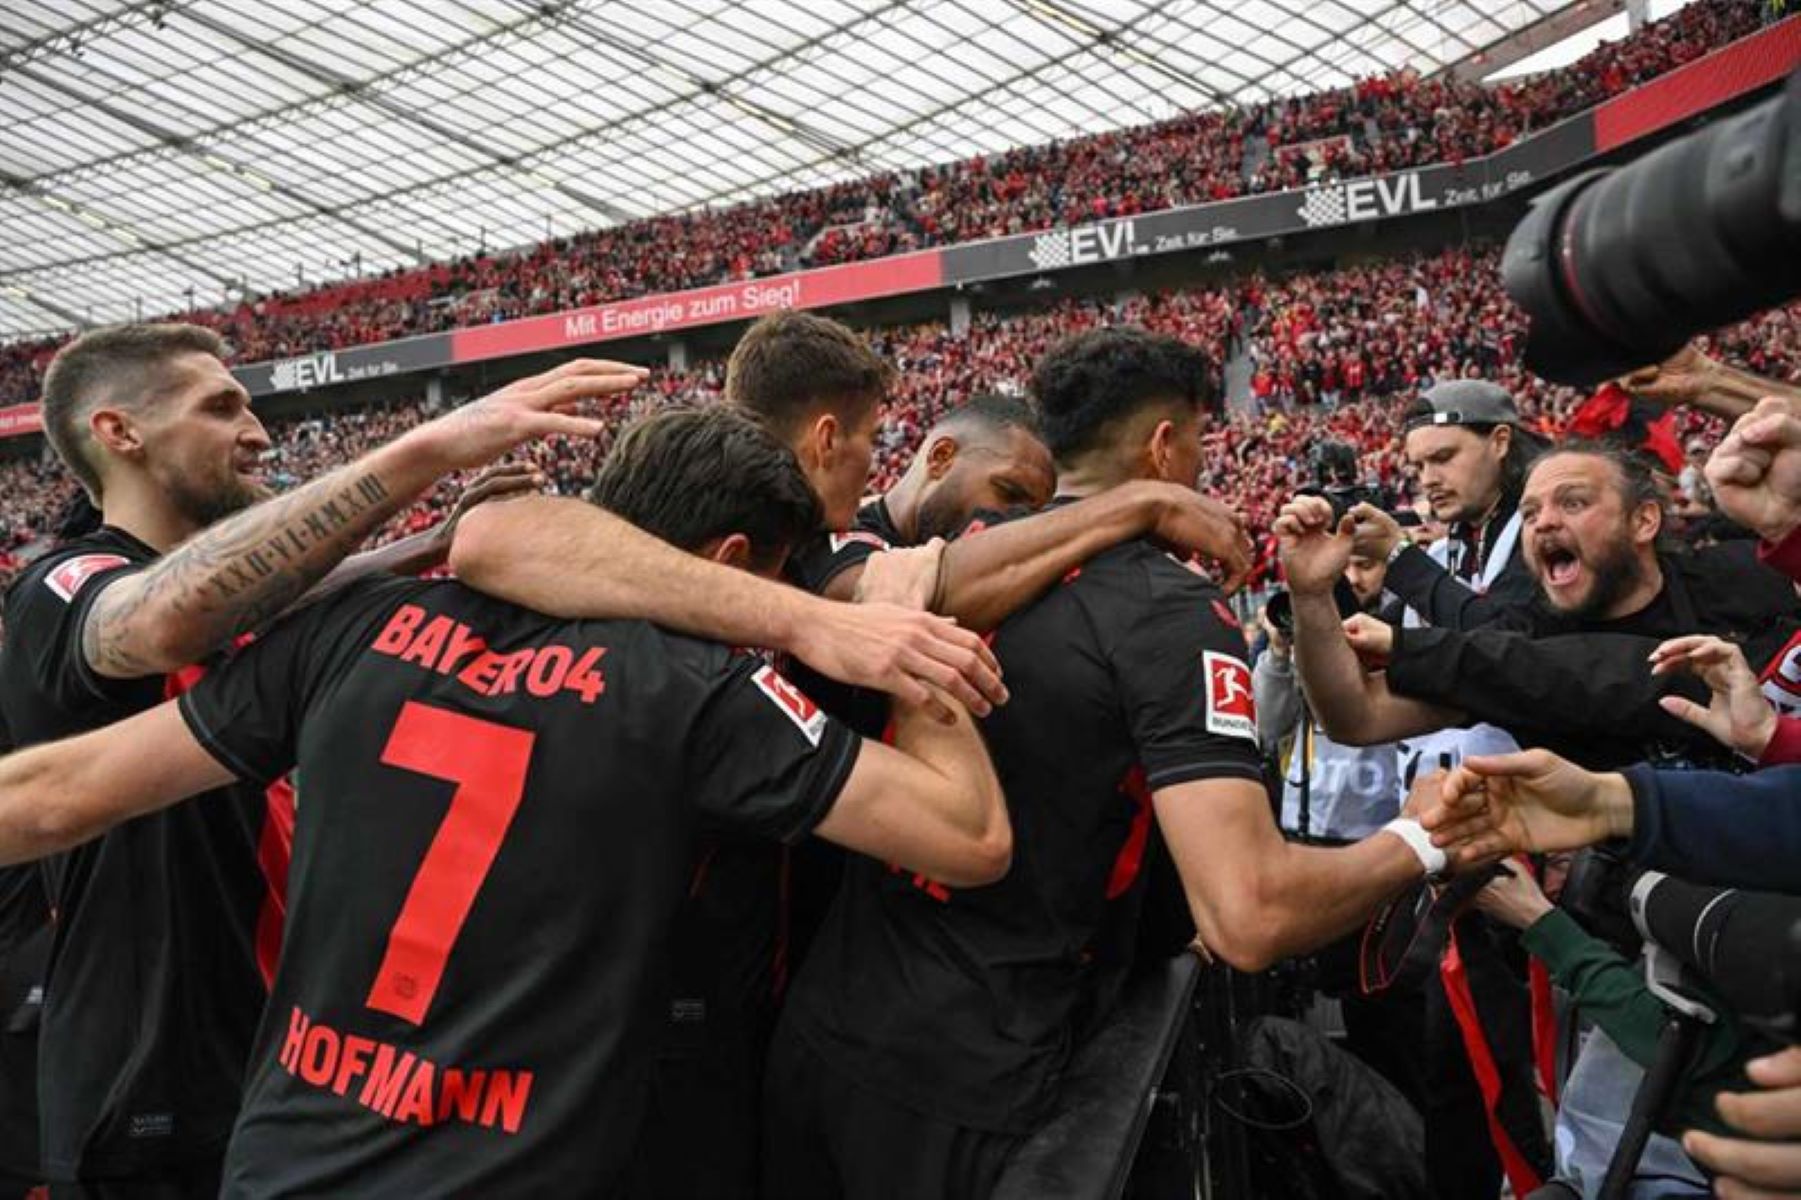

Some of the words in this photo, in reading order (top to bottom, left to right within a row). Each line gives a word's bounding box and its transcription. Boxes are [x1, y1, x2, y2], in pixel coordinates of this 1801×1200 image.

[1347, 172, 1437, 222] EVL
[1071, 221, 1149, 263] EVL
[565, 315, 597, 338] Mit
[602, 302, 683, 329] Energie
[689, 295, 736, 317] zum
[743, 278, 800, 308] Sieg!
[296, 352, 344, 387] EVL
[366, 702, 535, 1025] 7
[281, 1007, 532, 1133] HOFMANN
